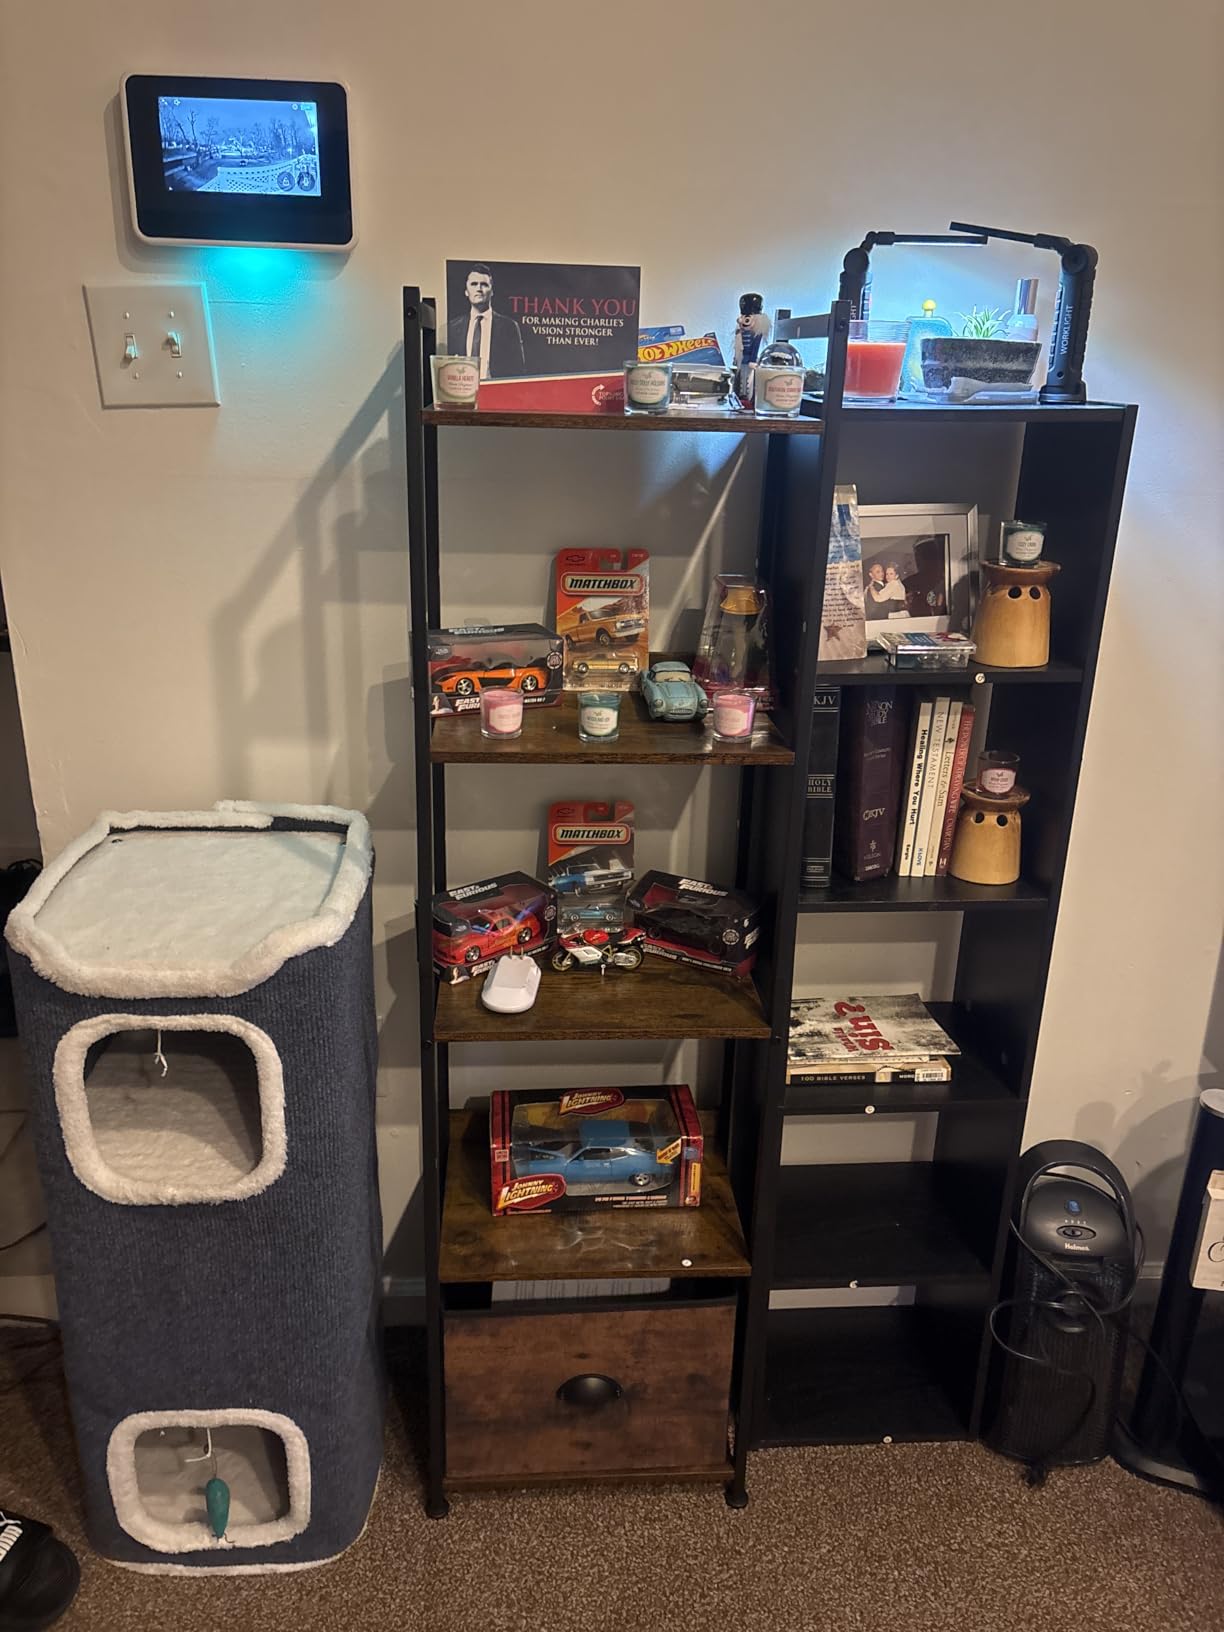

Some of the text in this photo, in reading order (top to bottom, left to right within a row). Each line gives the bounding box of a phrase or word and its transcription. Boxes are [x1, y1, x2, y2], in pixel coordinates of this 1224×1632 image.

[508, 296, 636, 316] THANK YOU
[522, 316, 624, 327] FOR MAKING CHARLIE'S
[532, 326, 613, 336] VISION STRONGER
[1059, 304, 1073, 355] WORKLIGHT
[546, 336, 599, 346] THAN EVER!
[569, 578, 637, 589] MATCHBOX
[813, 696, 836, 705] KJV
[927, 711, 944, 788] NEW TESTAMENT
[943, 750, 954, 779] Letters
[909, 729, 928, 825] Healing Where You Hurt
[937, 790, 945, 807] Sam
[559, 828, 623, 839] MATCHBOX
[678, 884, 729, 897] FURIOUS
[560, 1095, 612, 1115] LIGHTNING
[511, 1179, 544, 1191] JOHNNY
[498, 1184, 553, 1209] LIGHTNING
